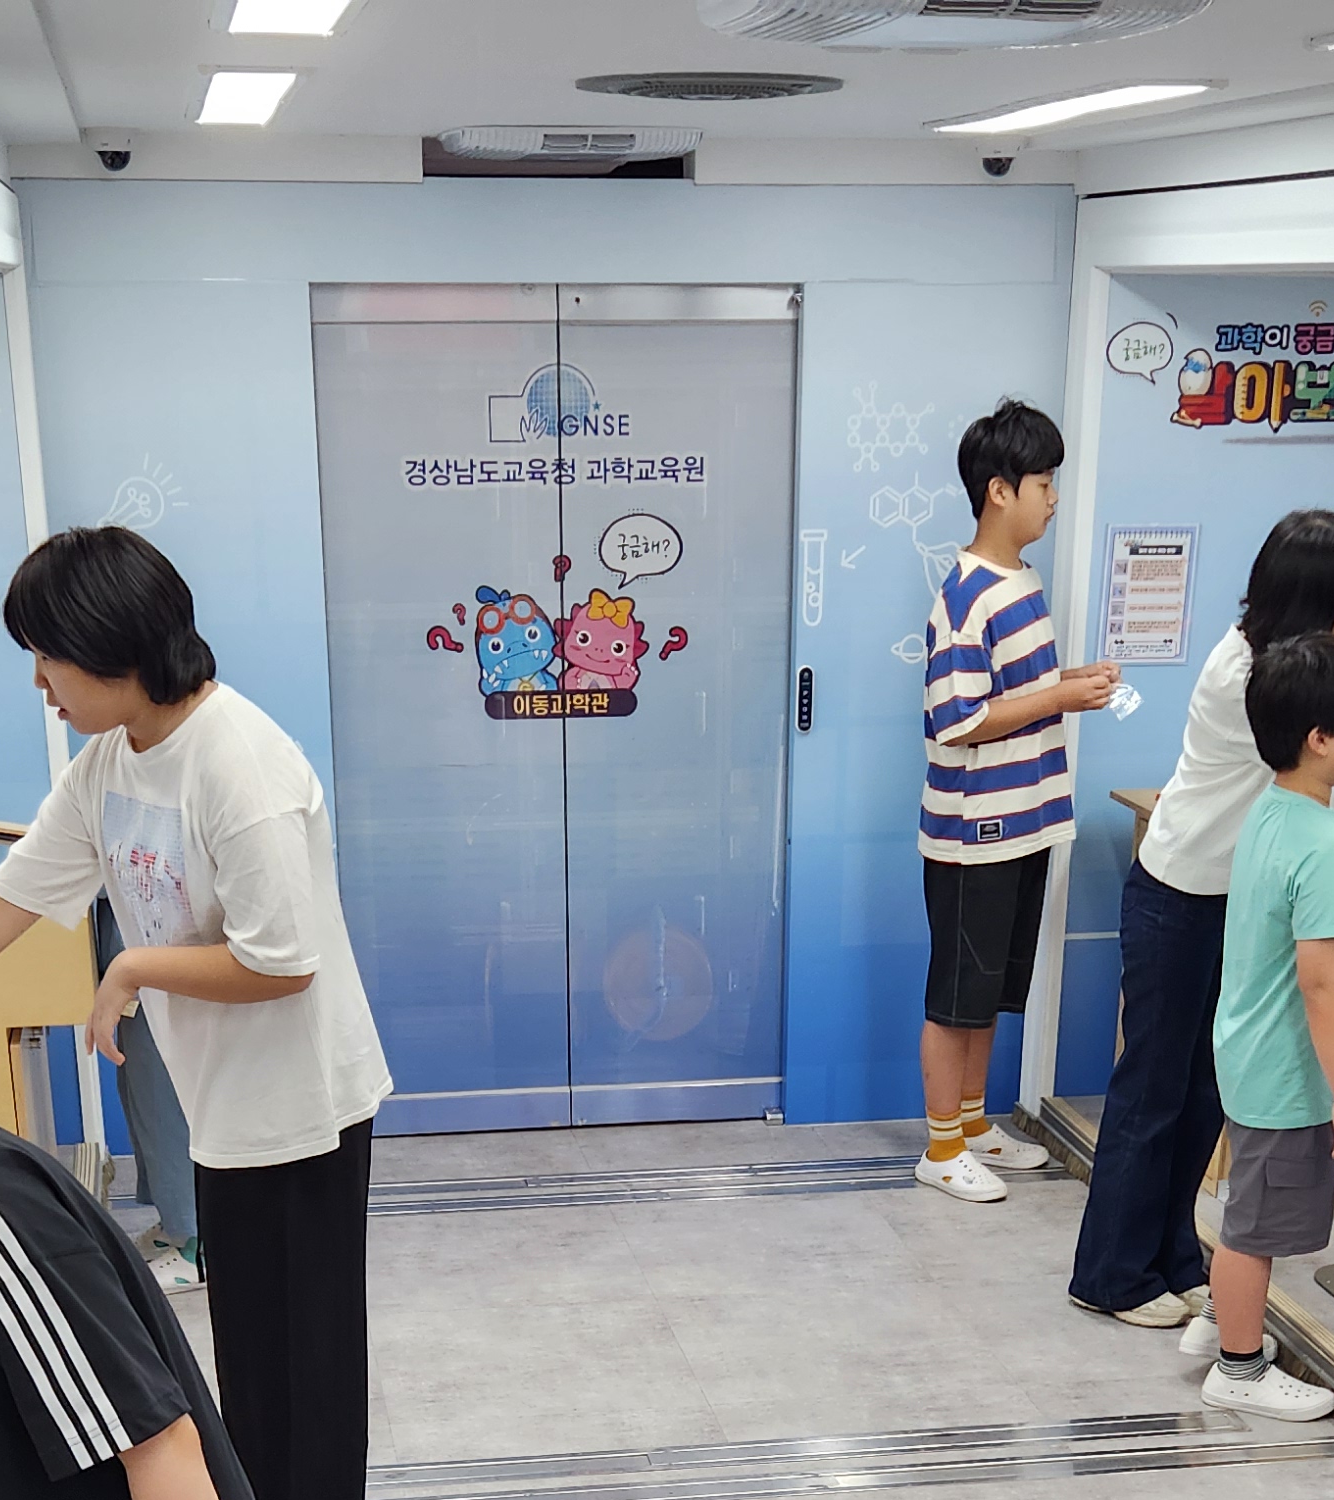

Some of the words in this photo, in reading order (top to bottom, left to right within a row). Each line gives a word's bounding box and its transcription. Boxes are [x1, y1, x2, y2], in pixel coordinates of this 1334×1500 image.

[1123, 338, 1166, 362] 궁금해?
[1215, 323, 1289, 353] 과학이
[560, 413, 631, 437] GNSE
[404, 457, 578, 486] 경상남도교육청
[586, 455, 706, 485] 과학교육원
[616, 533, 671, 560] 궁금해?
[513, 693, 610, 716] 이동과학관
